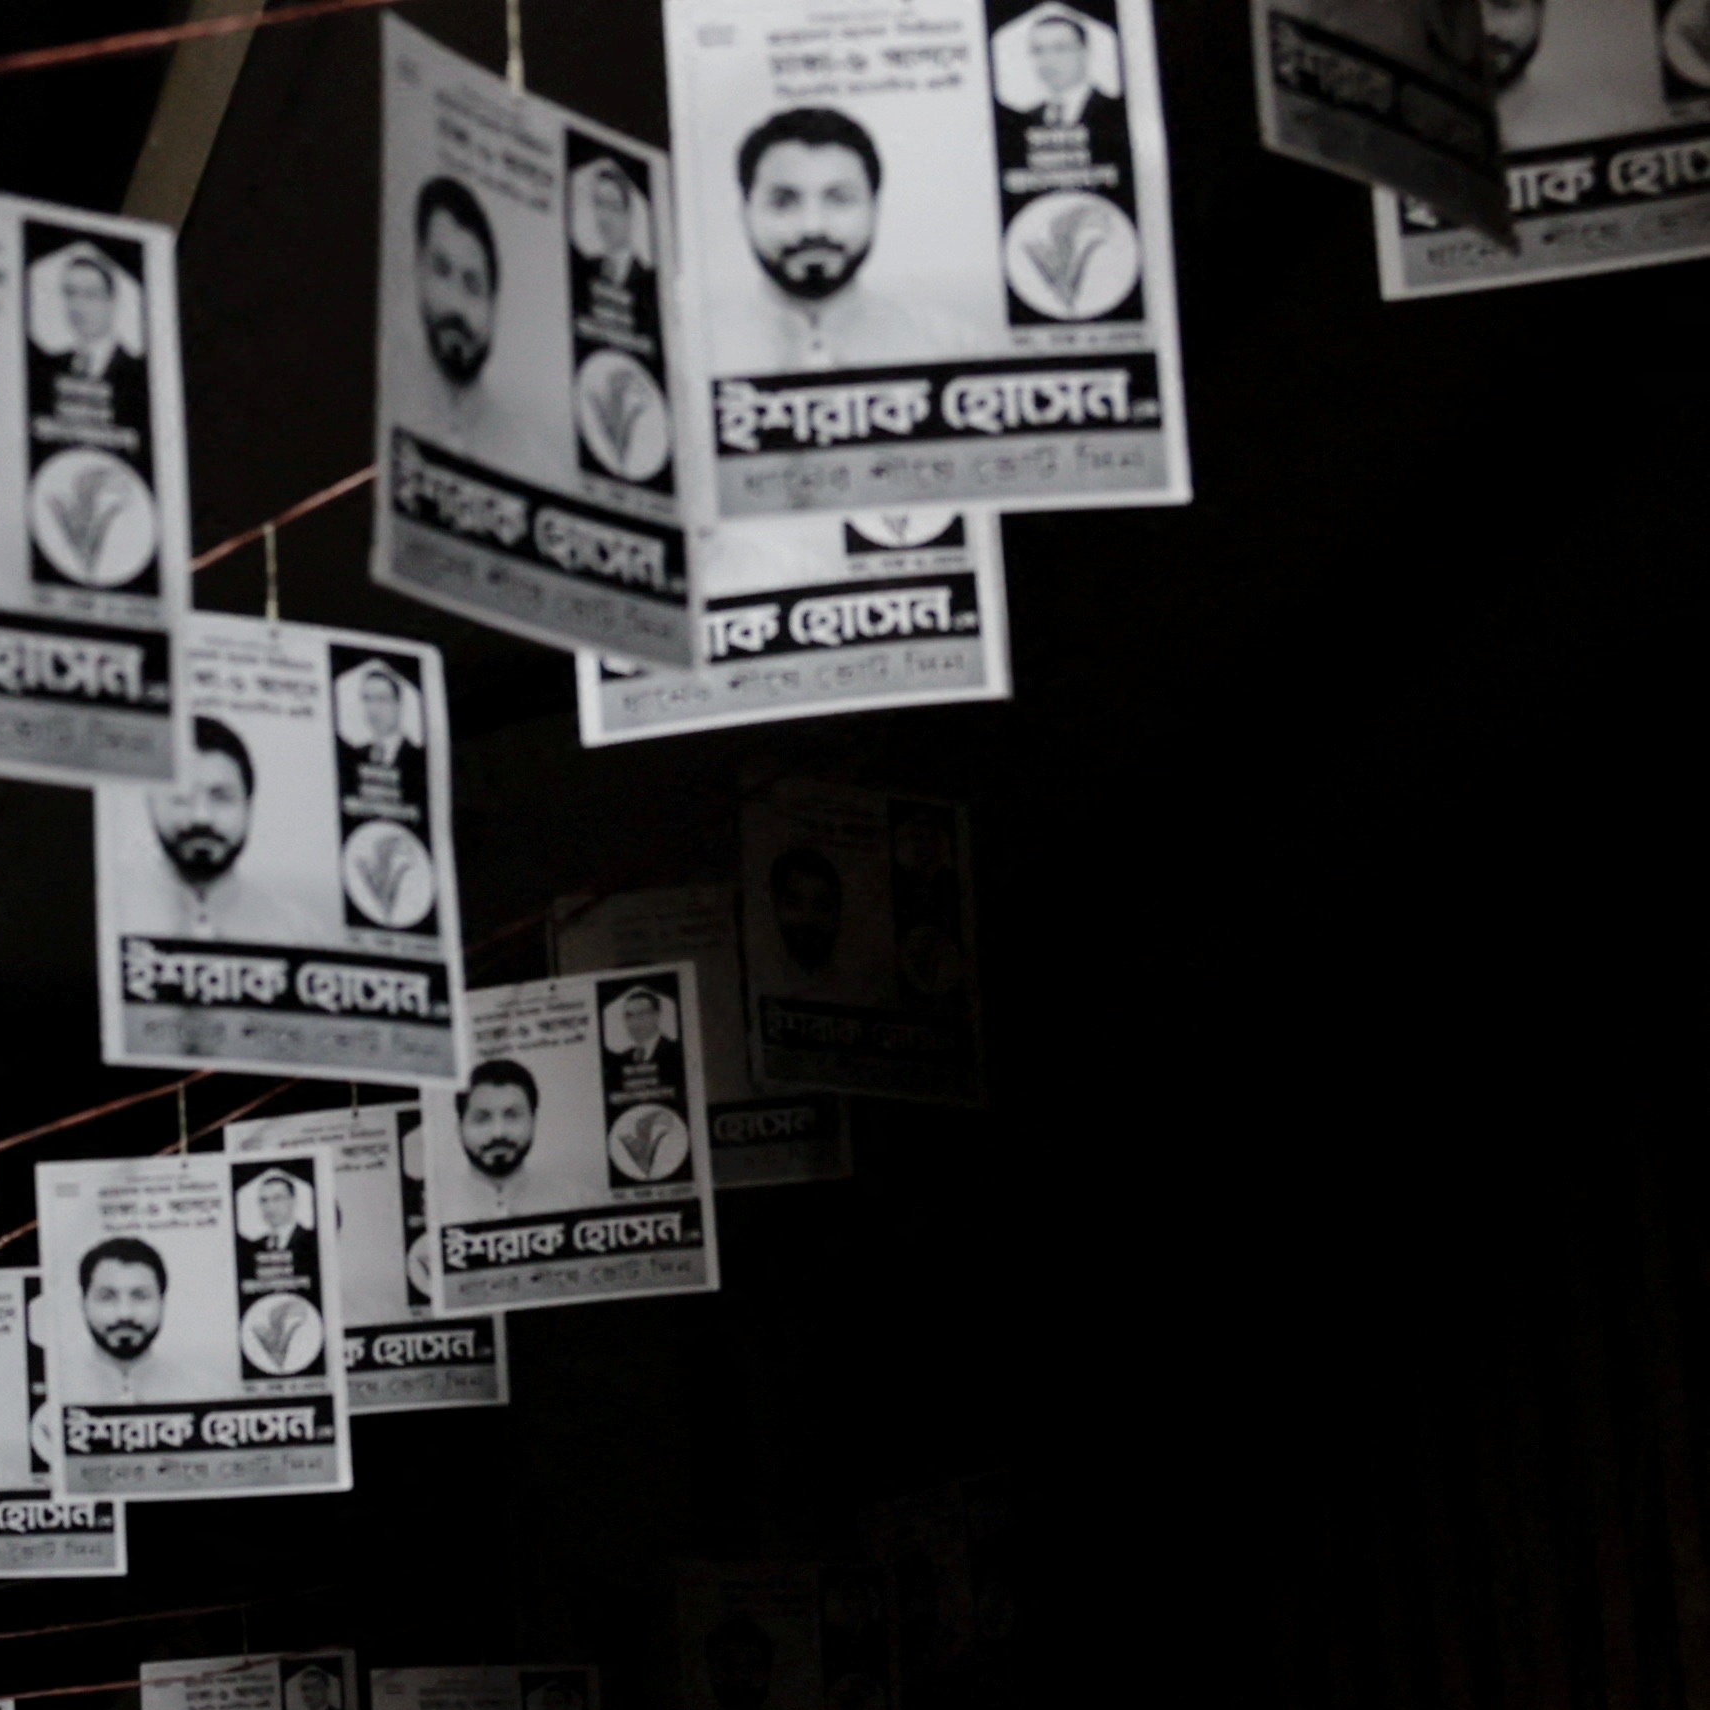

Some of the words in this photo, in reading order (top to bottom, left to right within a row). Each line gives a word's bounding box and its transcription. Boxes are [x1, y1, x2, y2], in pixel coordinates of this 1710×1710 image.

[718, 376, 935, 451] ইশরাক
[941, 367, 1133, 432] হোসেন
[788, 585, 953, 648] হোসেন
[124, 941, 293, 1008] ইশরাক
[295, 962, 432, 1016] হোসেন
[444, 1222, 567, 1272] ইশরাক
[571, 1210, 683, 1255] হোসেন
[370, 1328, 477, 1370] হোসেন
[67, 1404, 194, 1454] ইশরাক
[200, 1405, 316, 1447] হোসেন
